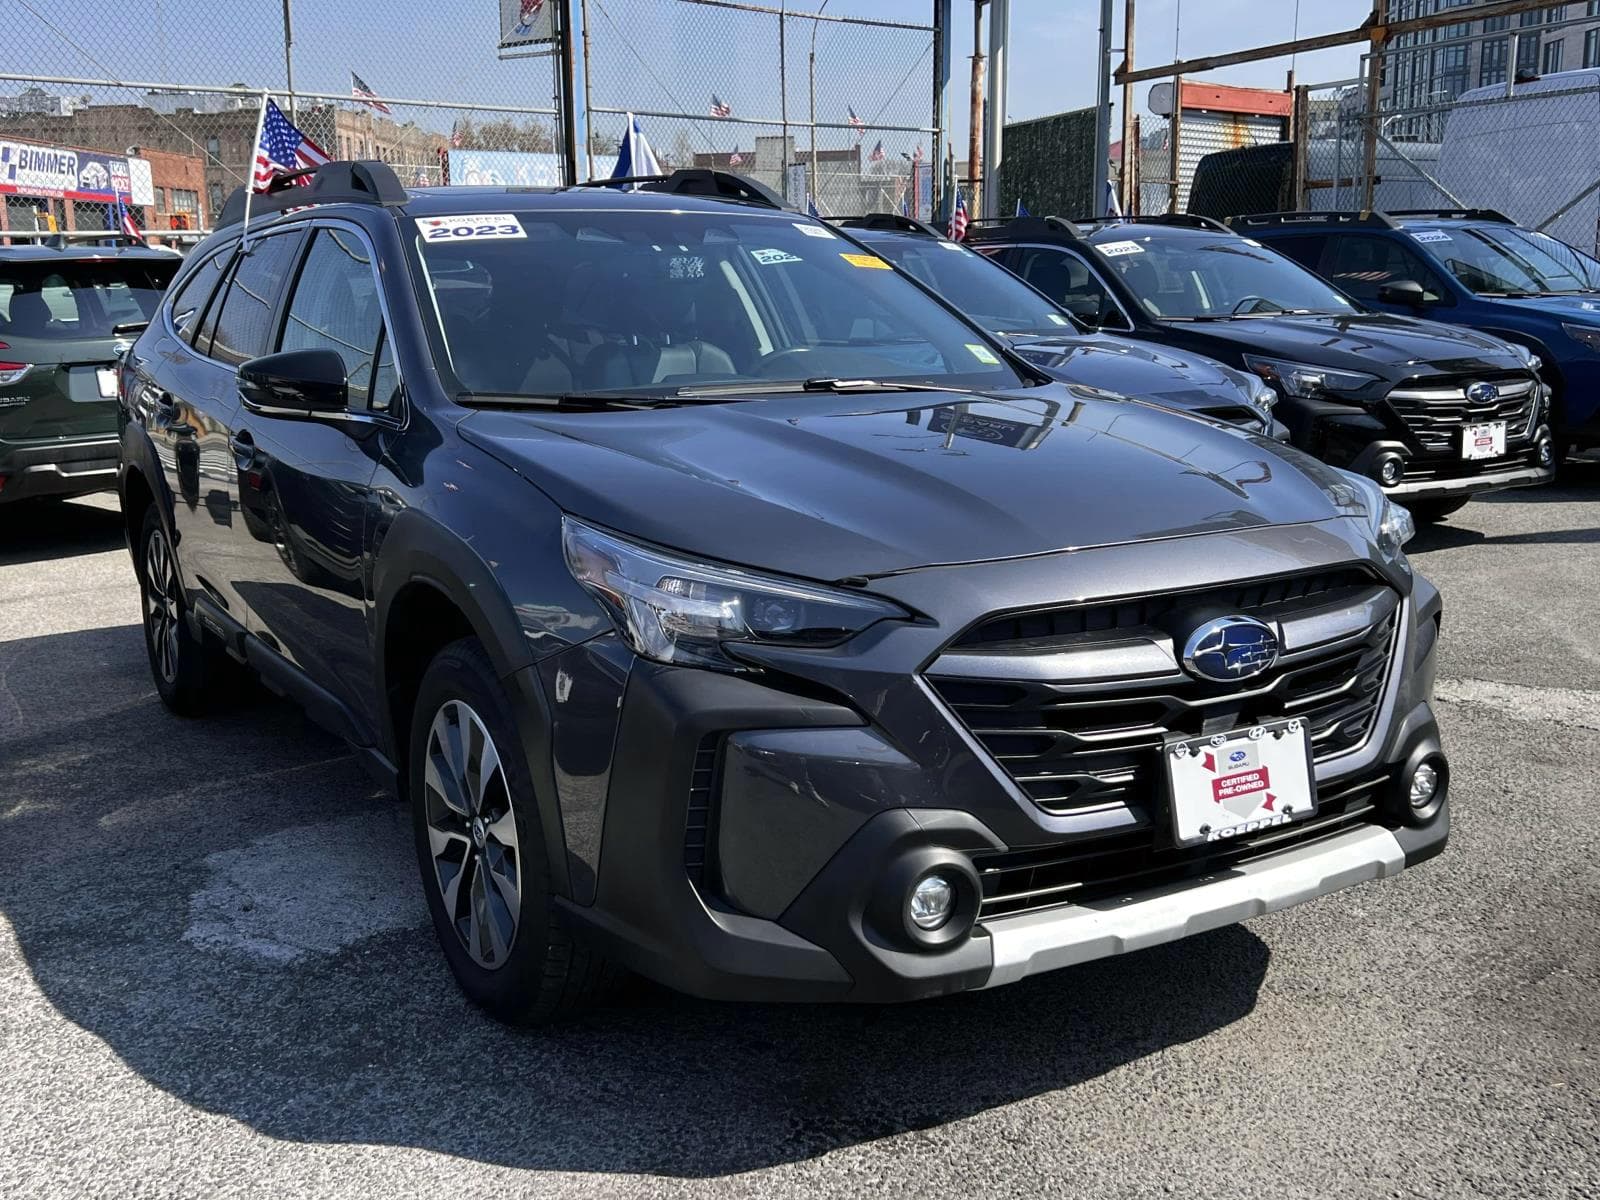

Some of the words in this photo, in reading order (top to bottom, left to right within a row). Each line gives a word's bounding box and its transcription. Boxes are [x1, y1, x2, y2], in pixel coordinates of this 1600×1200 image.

[18, 149, 76, 176] BIMMER
[428, 224, 520, 239] 2023
[1218, 779, 1264, 796] PRE-OWNED
[1221, 773, 1260, 788] CERTIFIED
[1207, 814, 1292, 842] KOEPPEL
